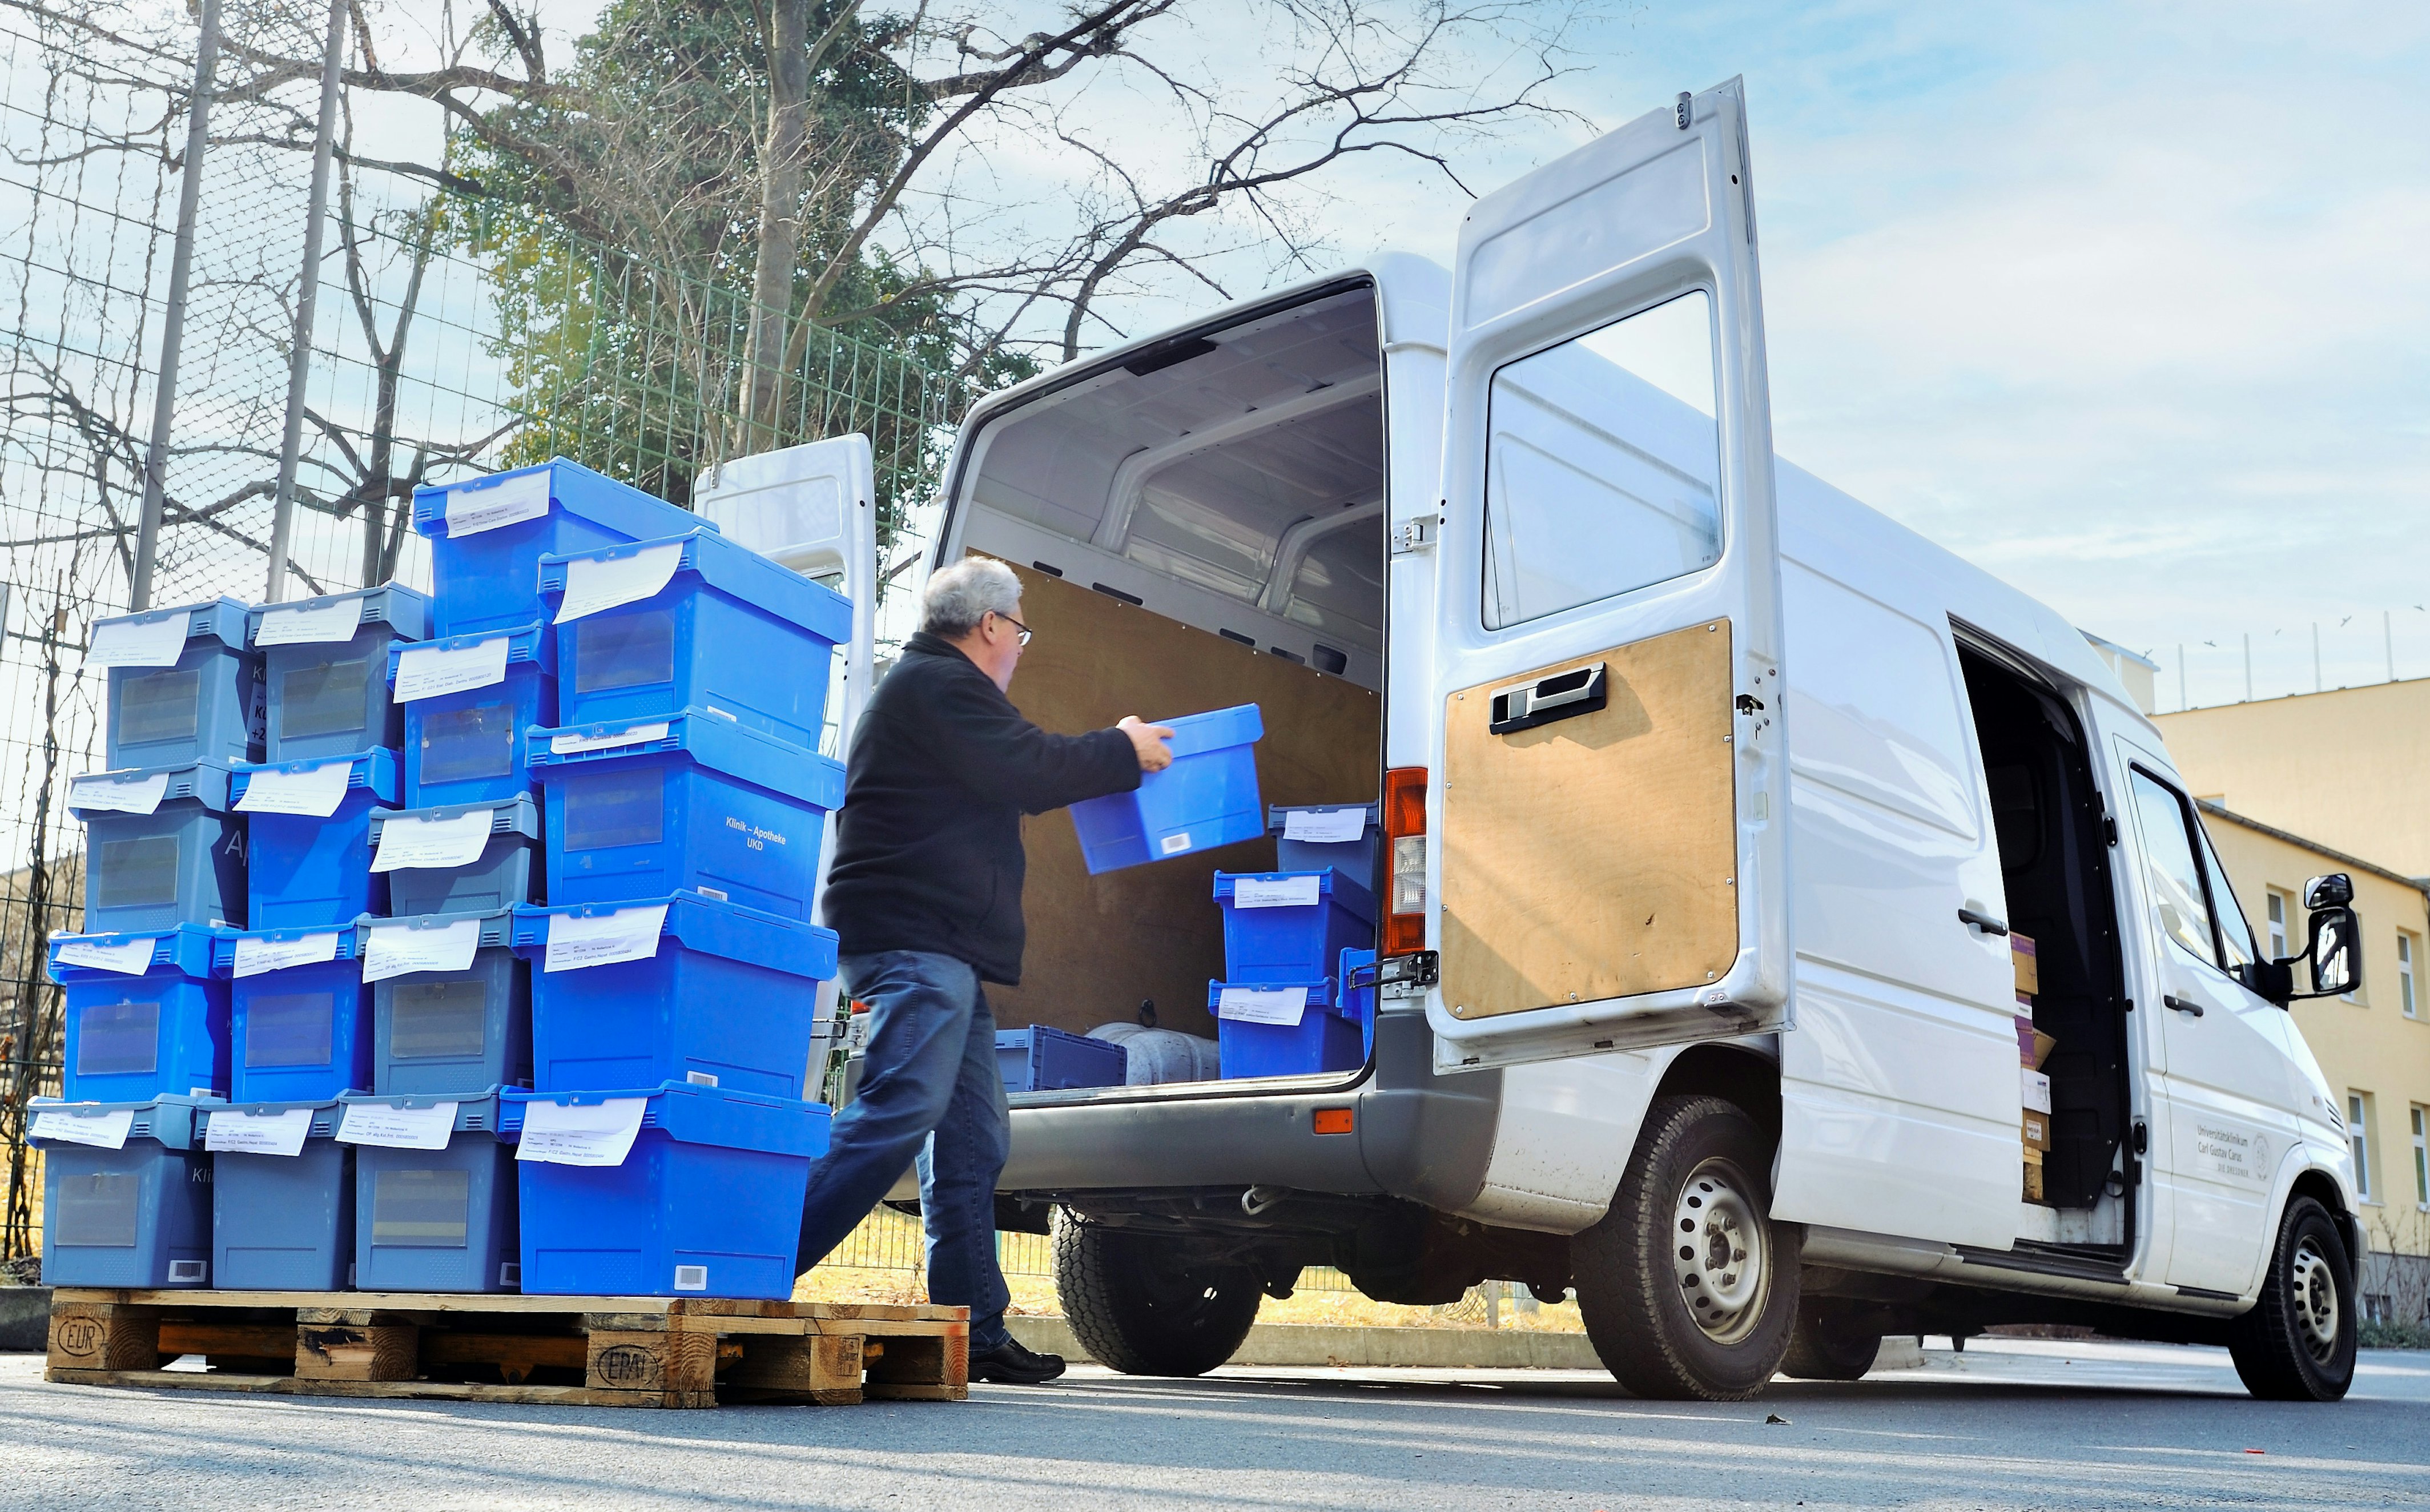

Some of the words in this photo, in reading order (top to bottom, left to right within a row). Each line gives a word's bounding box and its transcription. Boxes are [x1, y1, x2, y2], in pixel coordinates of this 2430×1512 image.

[726, 817, 747, 832] Klinik
[753, 826, 786, 845] Apotheke
[747, 837, 763, 851] UKD
[2198, 1141, 2208, 1153] Carl
[2210, 1144, 2227, 1159] Gustav
[2228, 1149, 2242, 1162] Carus
[192, 1168, 214, 1183] Kli
[67, 1325, 95, 1349] EUR
